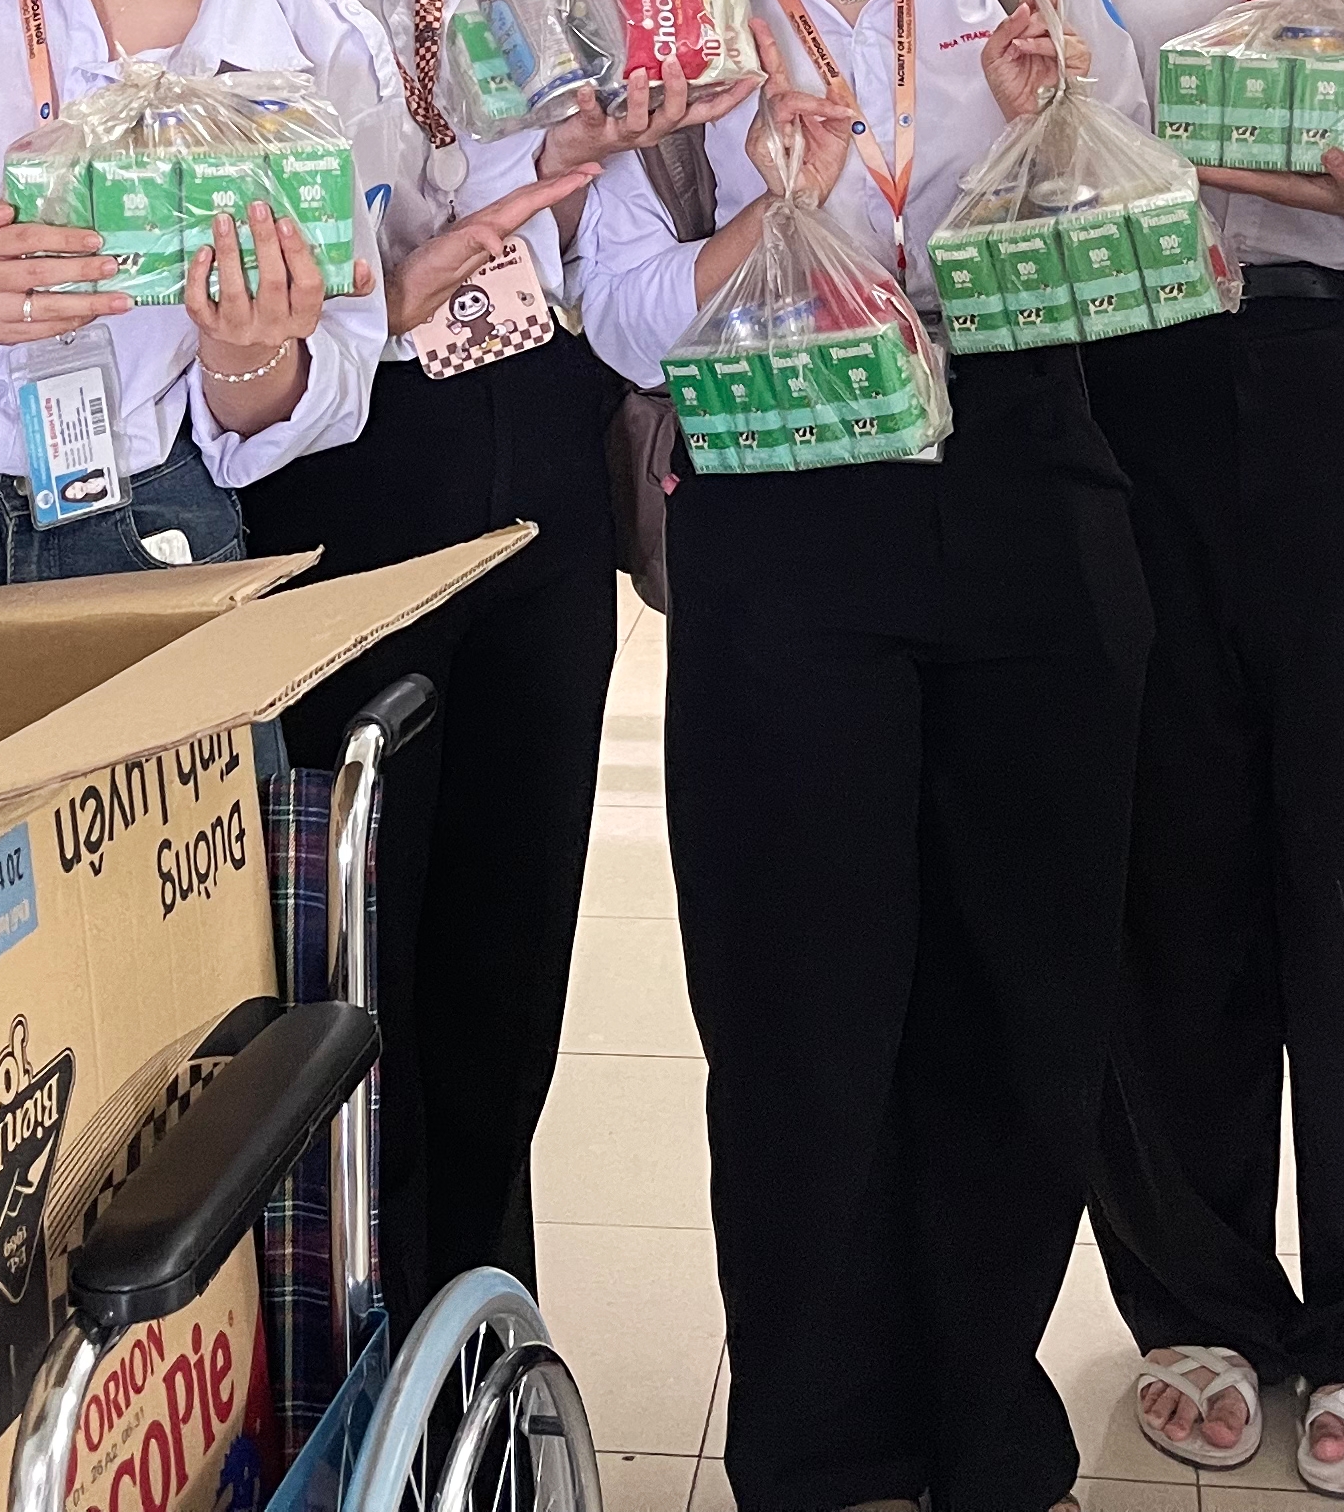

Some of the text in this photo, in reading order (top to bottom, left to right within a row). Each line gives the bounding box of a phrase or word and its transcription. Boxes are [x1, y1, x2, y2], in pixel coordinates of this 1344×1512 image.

[5, 847, 23, 886] 20
[157, 798, 246, 921] Đường
[84, 1319, 165, 1452] ORION
